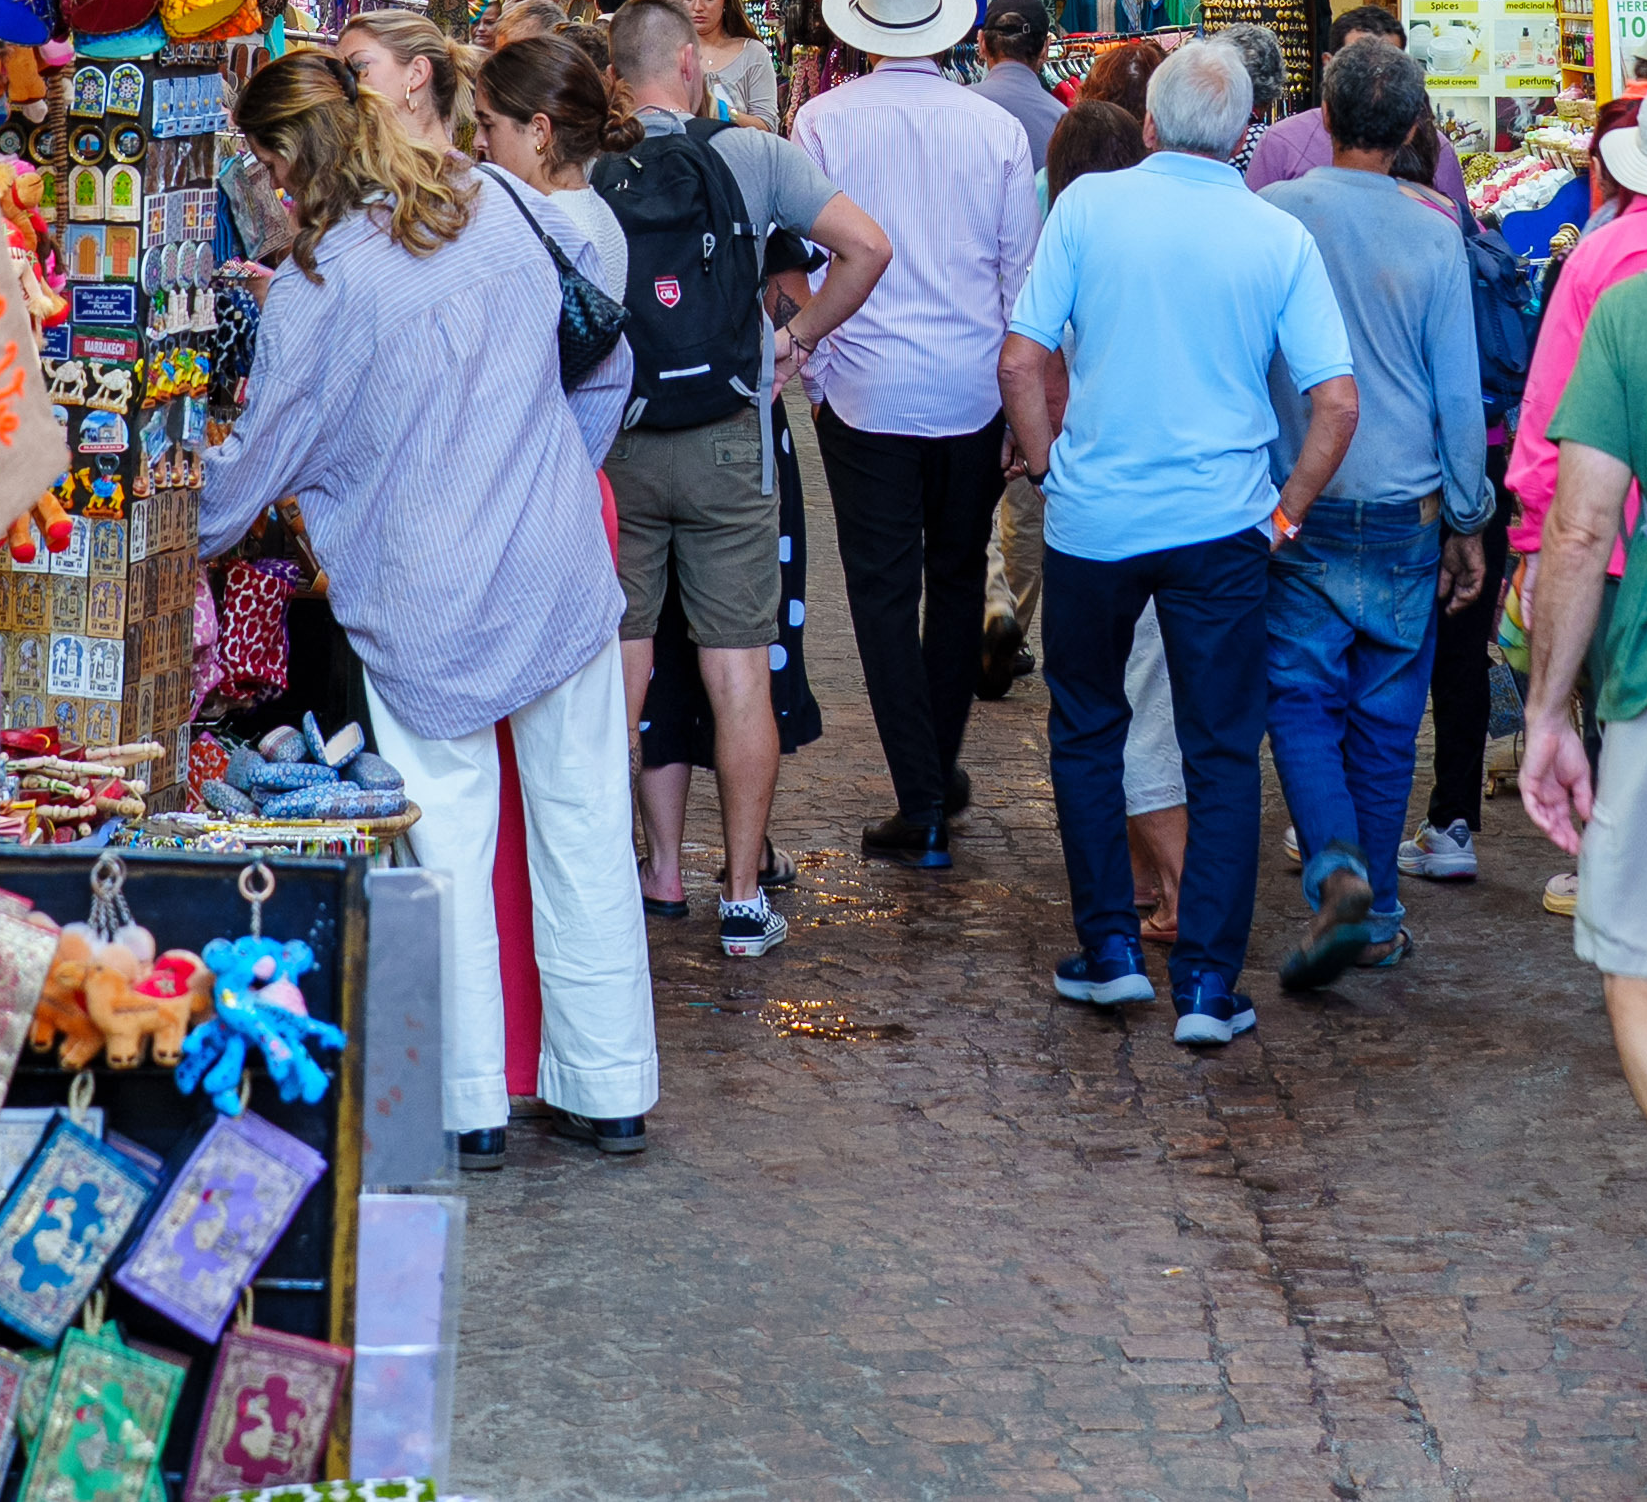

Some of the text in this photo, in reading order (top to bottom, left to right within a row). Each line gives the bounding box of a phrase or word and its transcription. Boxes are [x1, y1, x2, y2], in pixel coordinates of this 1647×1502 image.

[1430, 1, 1460, 12] Spices
[1506, 1, 1543, 10] medicinal
[1426, 78, 1452, 86] dicinal
[659, 289, 677, 299] OIL
[83, 339, 126, 355] MARRAKECH
